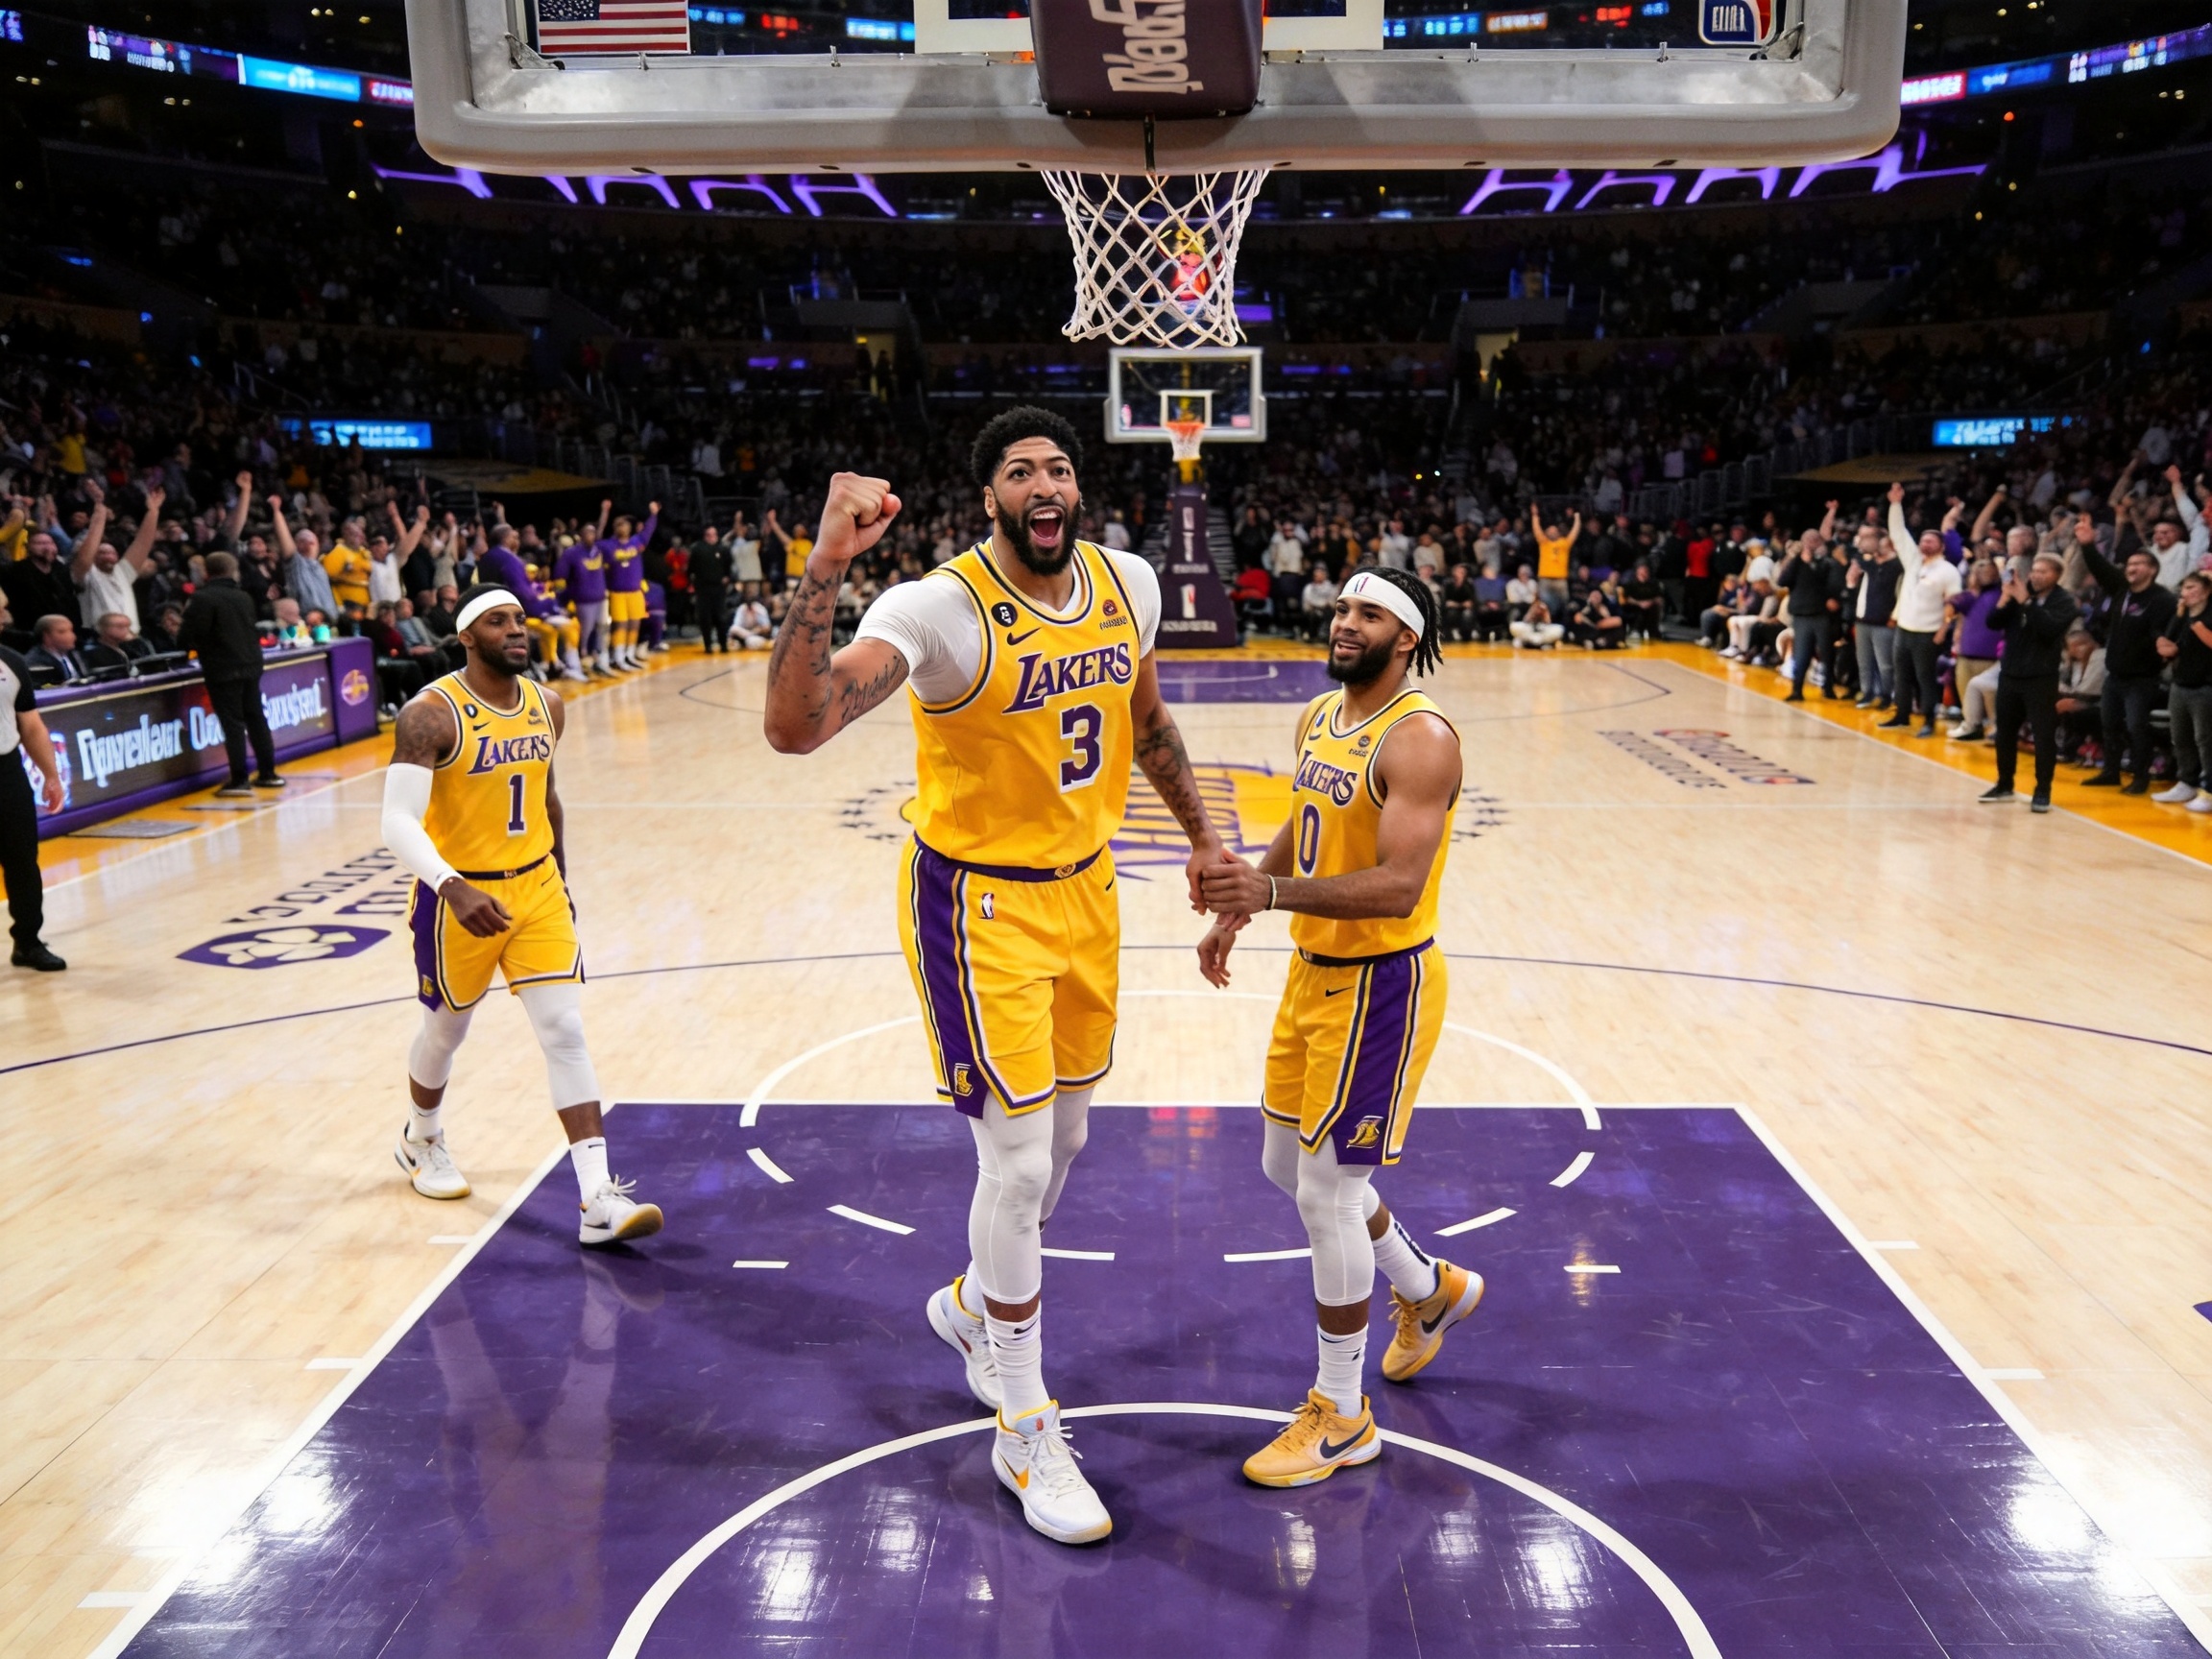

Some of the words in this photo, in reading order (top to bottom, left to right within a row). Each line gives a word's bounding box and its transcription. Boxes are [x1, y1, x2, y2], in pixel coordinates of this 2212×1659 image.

[1001, 642, 1133, 715] LAKERS
[467, 733, 550, 776] LAKERS
[1060, 702, 1105, 794] 3
[507, 774, 526, 836] 1
[1298, 802, 1322, 878] 0
